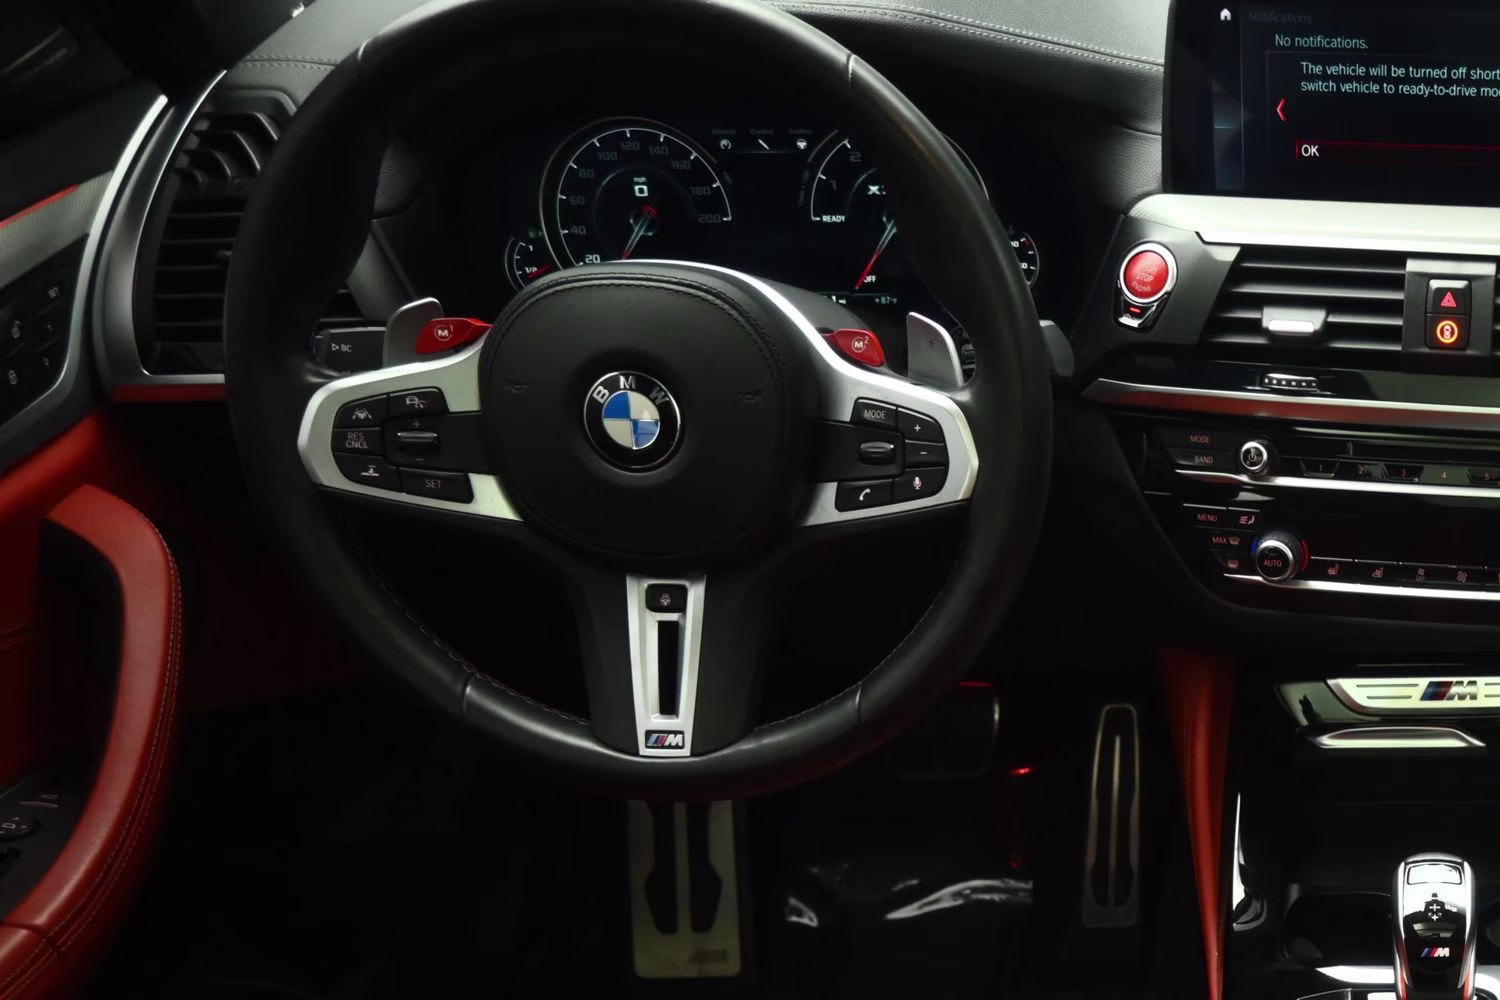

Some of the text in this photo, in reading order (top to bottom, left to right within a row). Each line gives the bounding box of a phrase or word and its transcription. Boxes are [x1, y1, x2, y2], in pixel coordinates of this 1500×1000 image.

[1275, 34, 1369, 49] No notifications.
[1300, 61, 1323, 75] The
[1327, 62, 1366, 76] vehicle
[1369, 64, 1387, 77] will
[1391, 64, 1405, 77] be
[1409, 65, 1447, 79] turned
[1450, 67, 1467, 80] off
[1300, 79, 1336, 92] switch
[1340, 80, 1379, 94] vehicle
[1383, 82, 1395, 94] to
[1399, 83, 1477, 98] ready-to-drive
[621, 141, 641, 151] 120
[650, 145, 669, 156] 140
[1301, 145, 1319, 157] OK
[598, 151, 618, 161] 100
[849, 151, 863, 162] 2
[671, 160, 691, 170] 160
[579, 168, 595, 179] 80
[633, 176, 647, 184] mph
[633, 184, 649, 197] 0
[690, 186, 711, 196] 180
[570, 195, 586, 205] 60
[698, 214, 721, 224] 200
[822, 215, 847, 223] READY
[570, 225, 587, 235] 40
[585, 254, 601, 263] 20
[1136, 271, 1155, 282] STOP
[340, 344, 352, 353] BC
[592, 375, 670, 406] BMW
[863, 410, 886, 420] MODE
[347, 432, 366, 441] RES
[1189, 435, 1212, 444] MODE
[345, 440, 368, 449] CNCL
[1194, 455, 1214, 464] BAND
[424, 479, 442, 489] SET
[1197, 513, 1219, 522] MENU
[1212, 536, 1228, 545] MAX
[1263, 559, 1283, 568] AUTO
